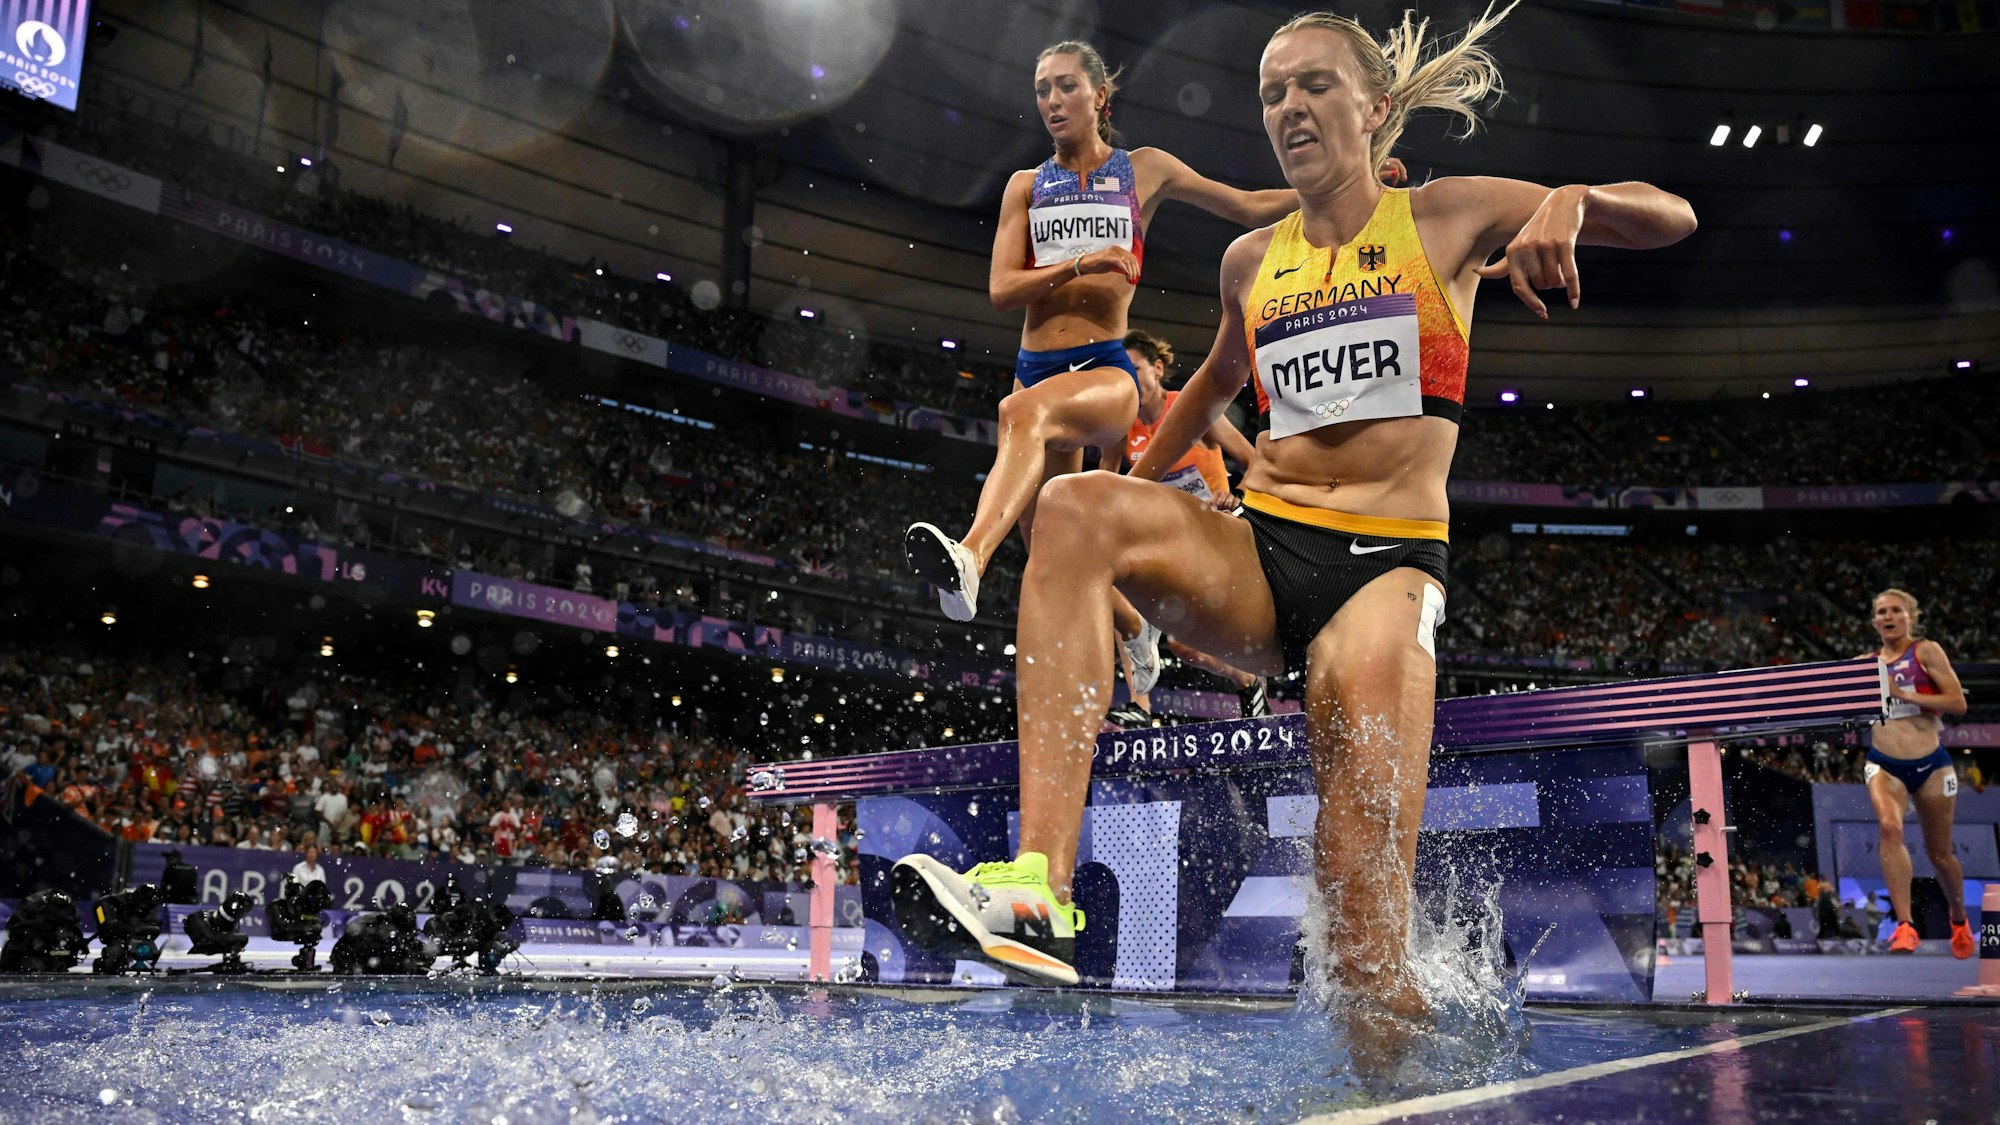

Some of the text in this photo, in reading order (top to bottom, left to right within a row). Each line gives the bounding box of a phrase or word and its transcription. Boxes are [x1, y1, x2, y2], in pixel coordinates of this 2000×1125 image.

[40, 67, 76, 90] 2024
[1054, 194, 1104, 204] PARIS 2024
[218, 212, 364, 269] PARIS 2024
[1034, 217, 1129, 243] WAYMENT
[1262, 274, 1401, 320] GERMANY
[1285, 305, 1368, 331] PARIS 2024
[706, 360, 812, 397] PARIS 2024
[1271, 339, 1401, 399] MEYER
[1798, 489, 1900, 502] PARIS 2024
[421, 576, 449, 598] K4
[470, 582, 604, 621] PARIS 2024
[793, 641, 898, 671] PARIS 2024
[1114, 726, 1294, 762] PARIS 2024
[342, 876, 435, 912] 202
